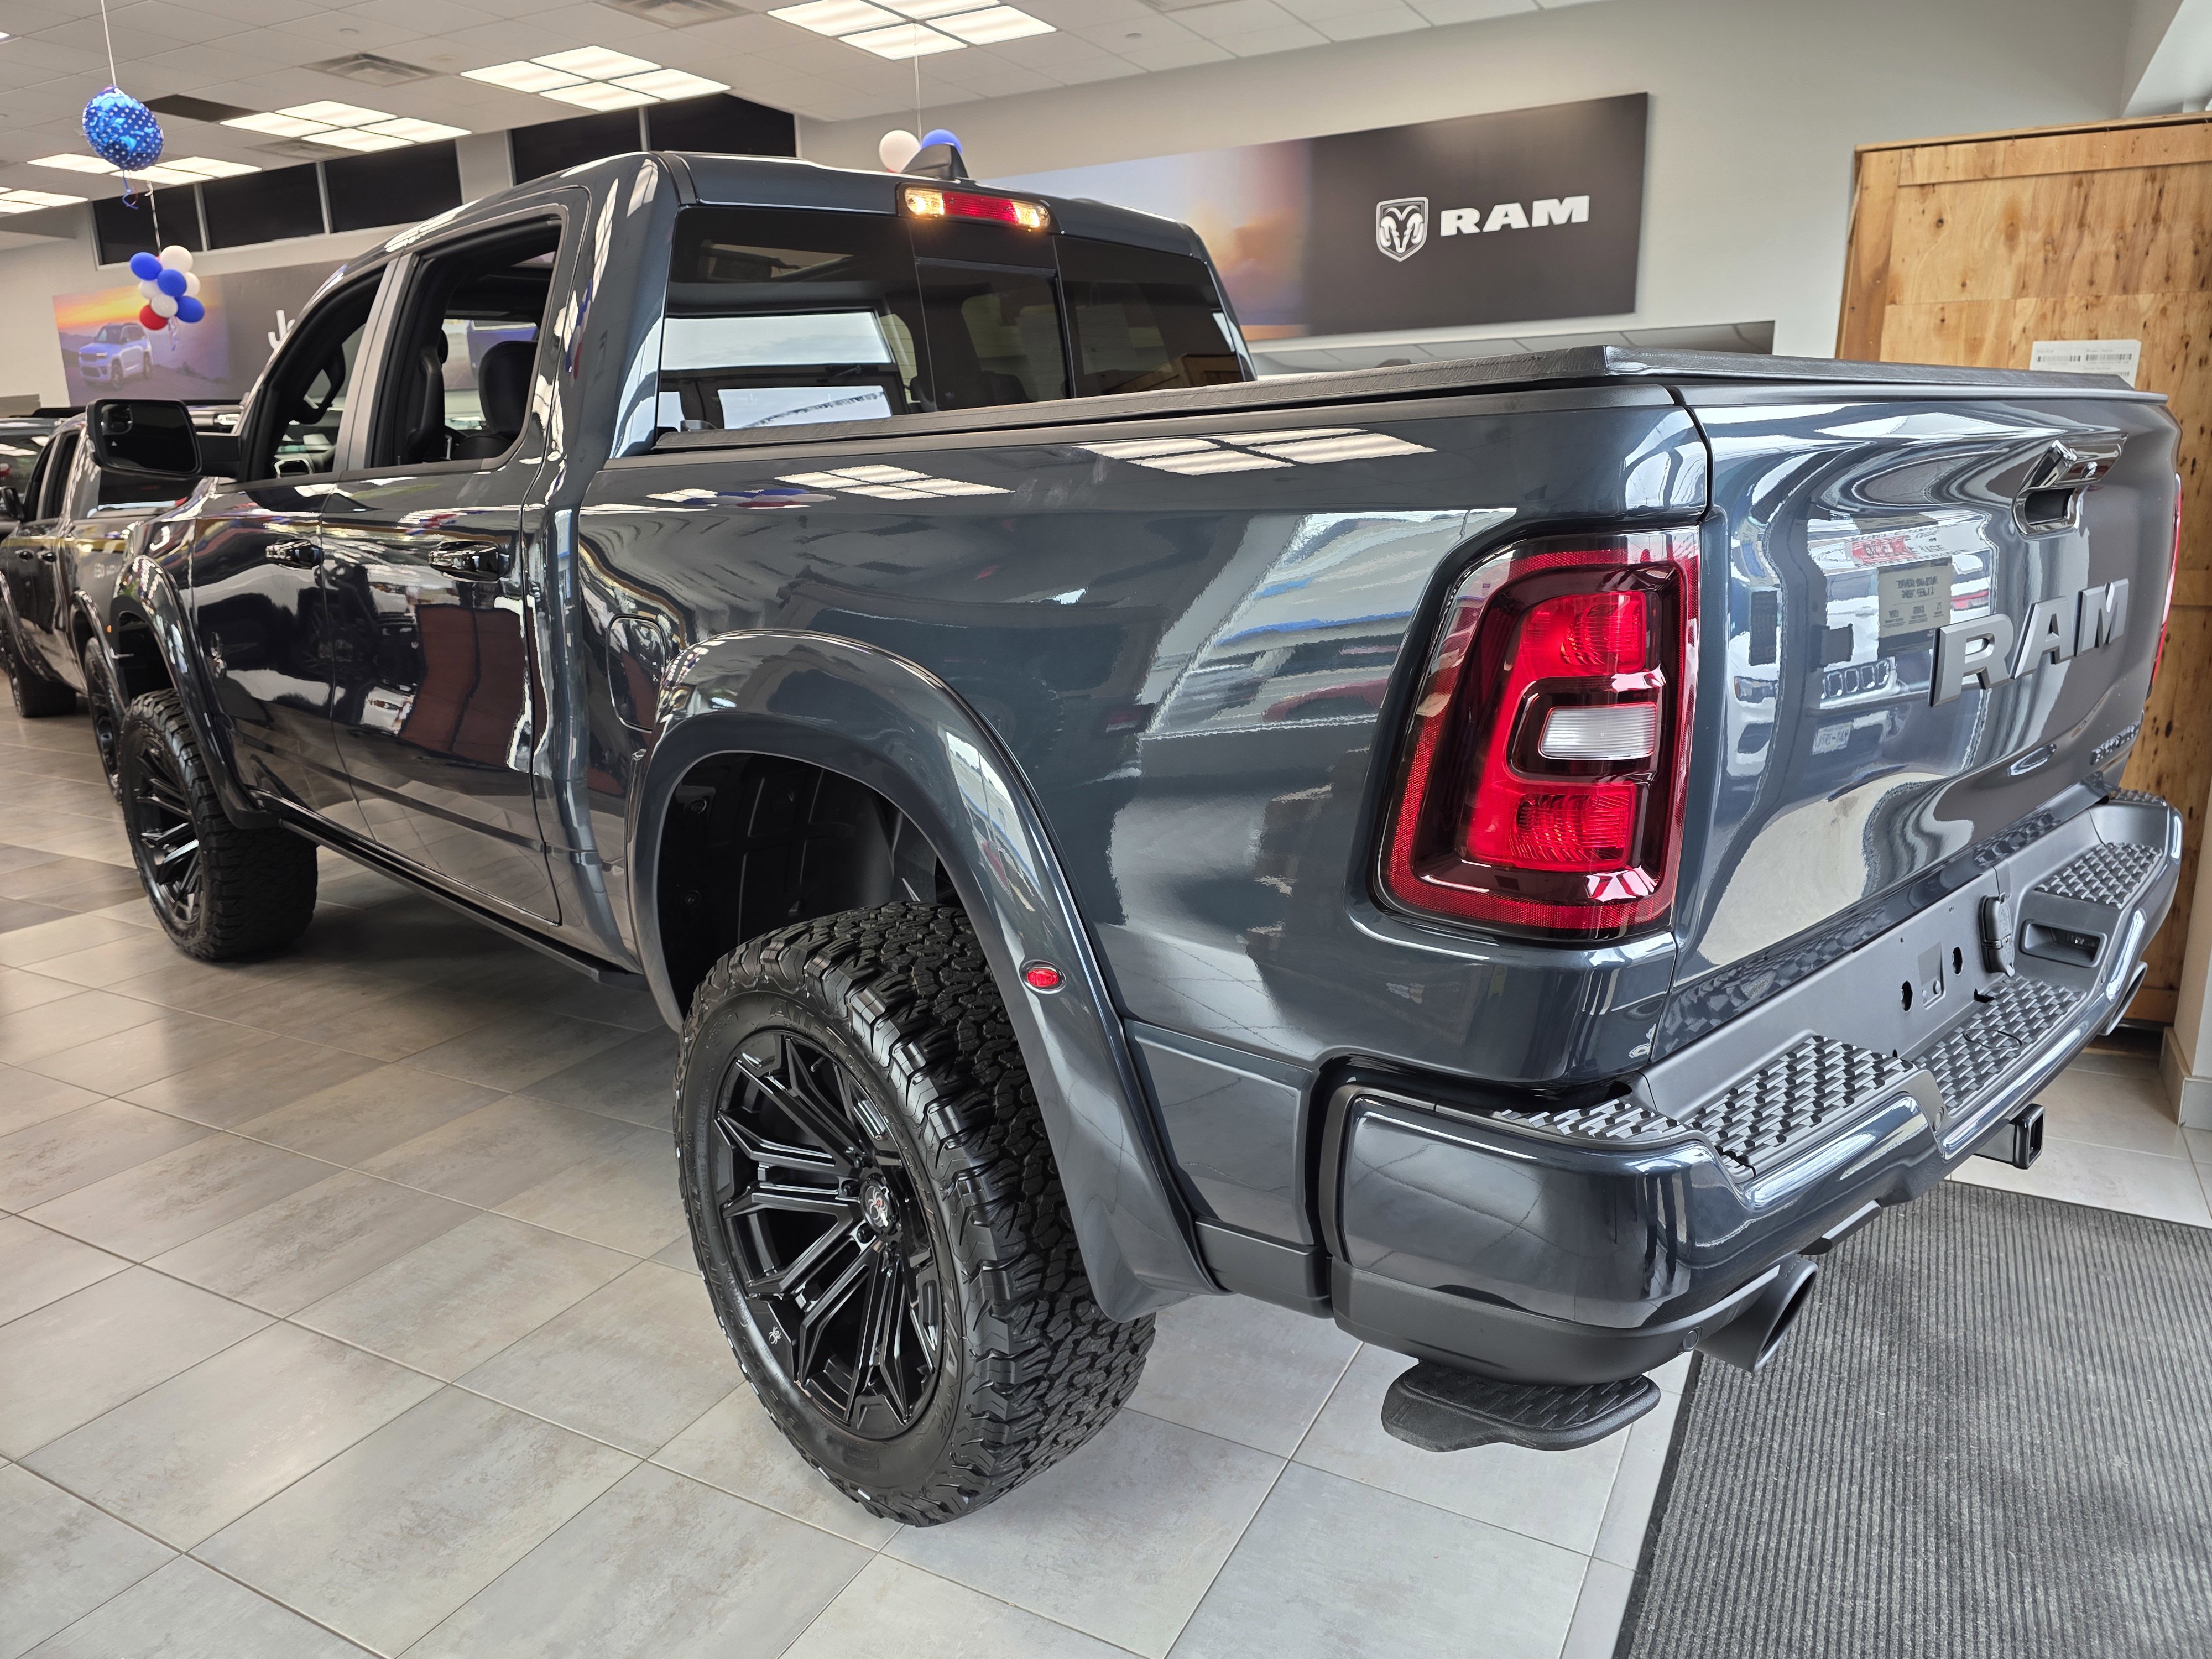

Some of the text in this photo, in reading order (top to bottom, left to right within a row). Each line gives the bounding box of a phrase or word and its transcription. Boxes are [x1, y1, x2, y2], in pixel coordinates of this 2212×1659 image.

[1440, 195, 1590, 237] RAM
[267, 310, 296, 349] J
[1929, 577, 2129, 707] RAM
